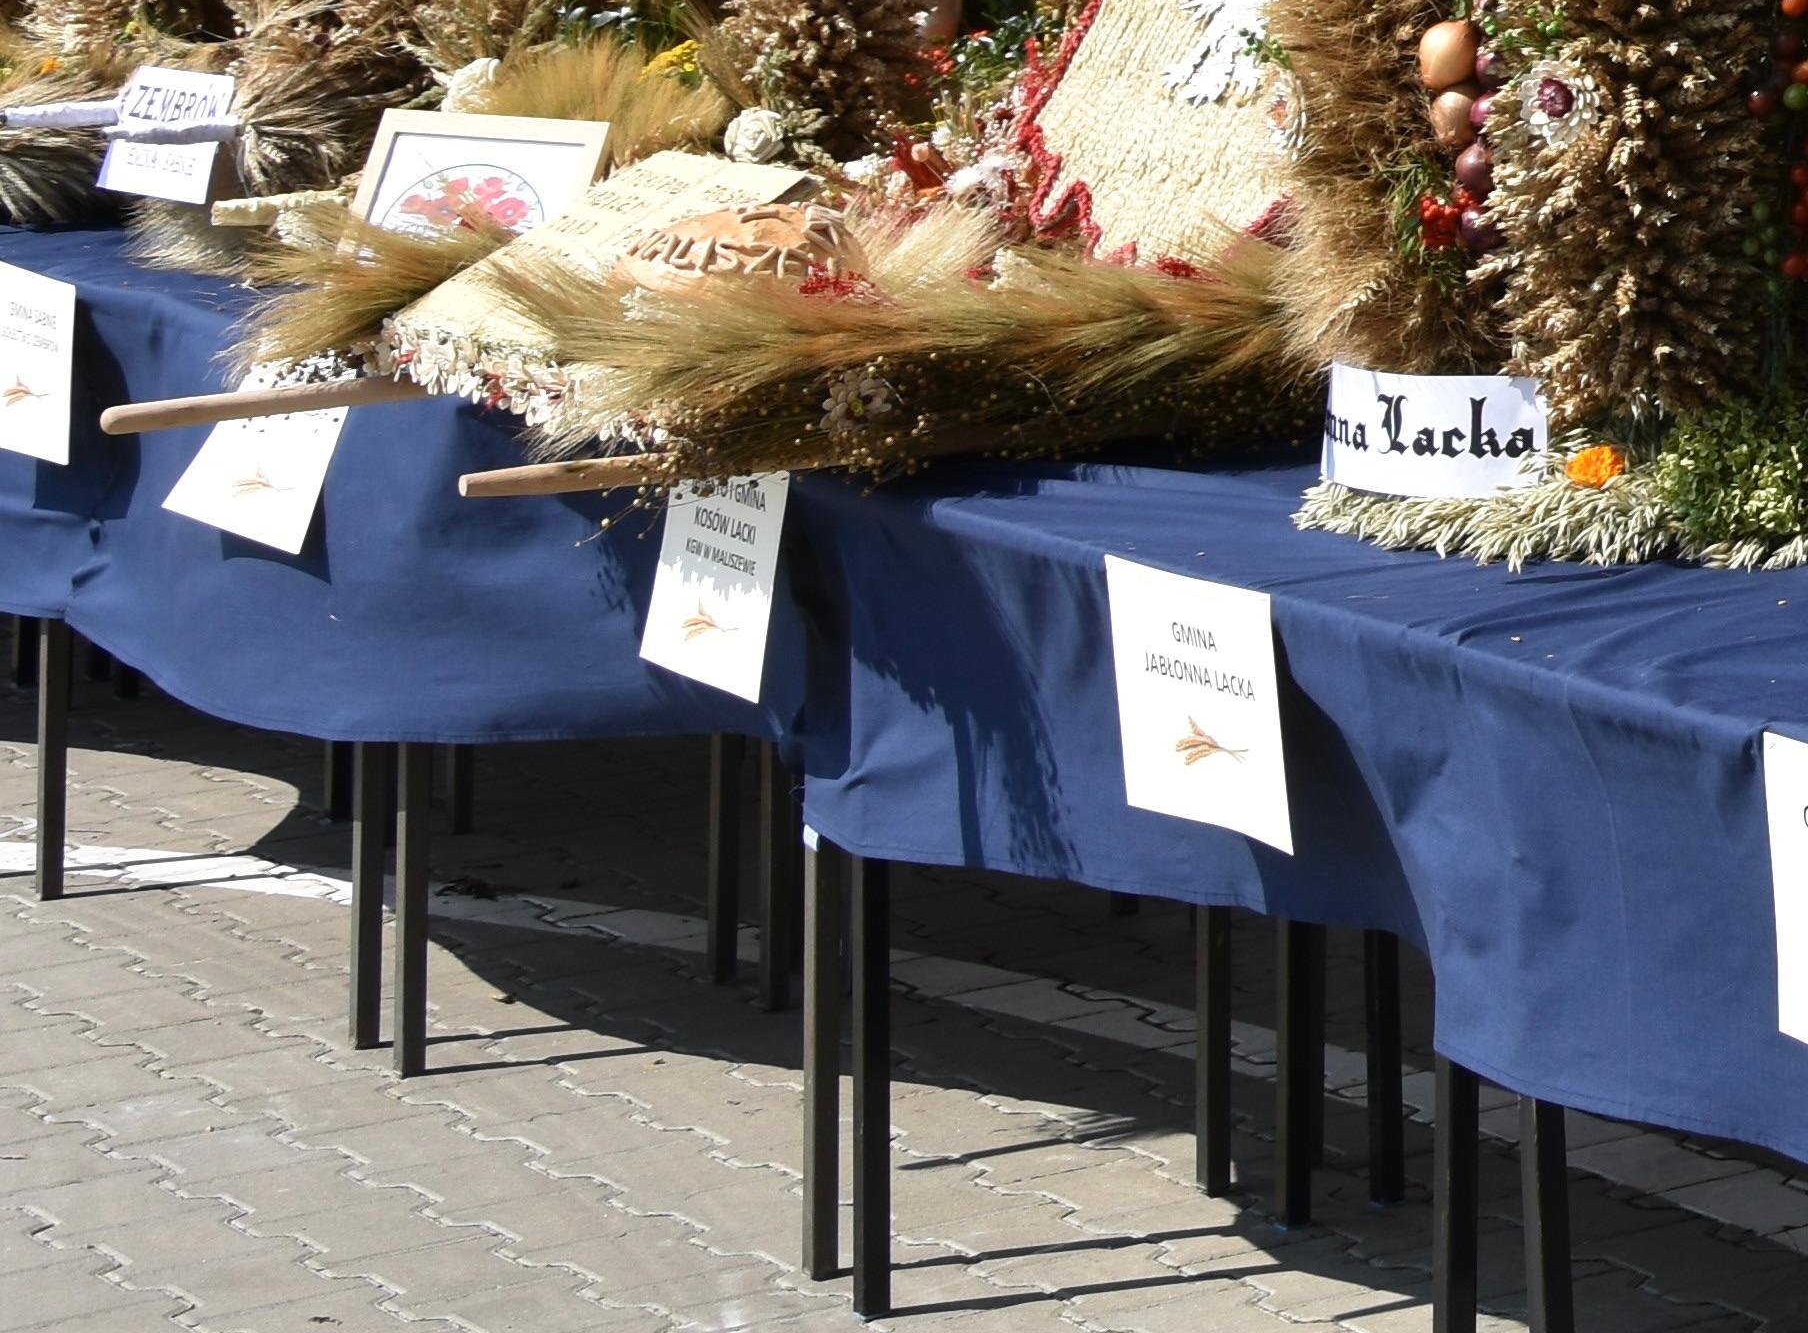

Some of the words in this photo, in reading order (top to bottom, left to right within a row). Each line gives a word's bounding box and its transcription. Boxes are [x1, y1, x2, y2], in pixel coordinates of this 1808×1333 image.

[128, 83, 226, 123] ZEMBRÓW
[1376, 393, 1542, 460] Lacka
[734, 483, 767, 513] GMINA
[694, 506, 730, 537] KOSÓW
[730, 518, 758, 546] LACKI
[711, 546, 758, 577] MALISZEWIE
[1171, 621, 1218, 653] GMINA
[1145, 651, 1213, 690] JABŁONNA
[1214, 670, 1256, 702] LACKA
